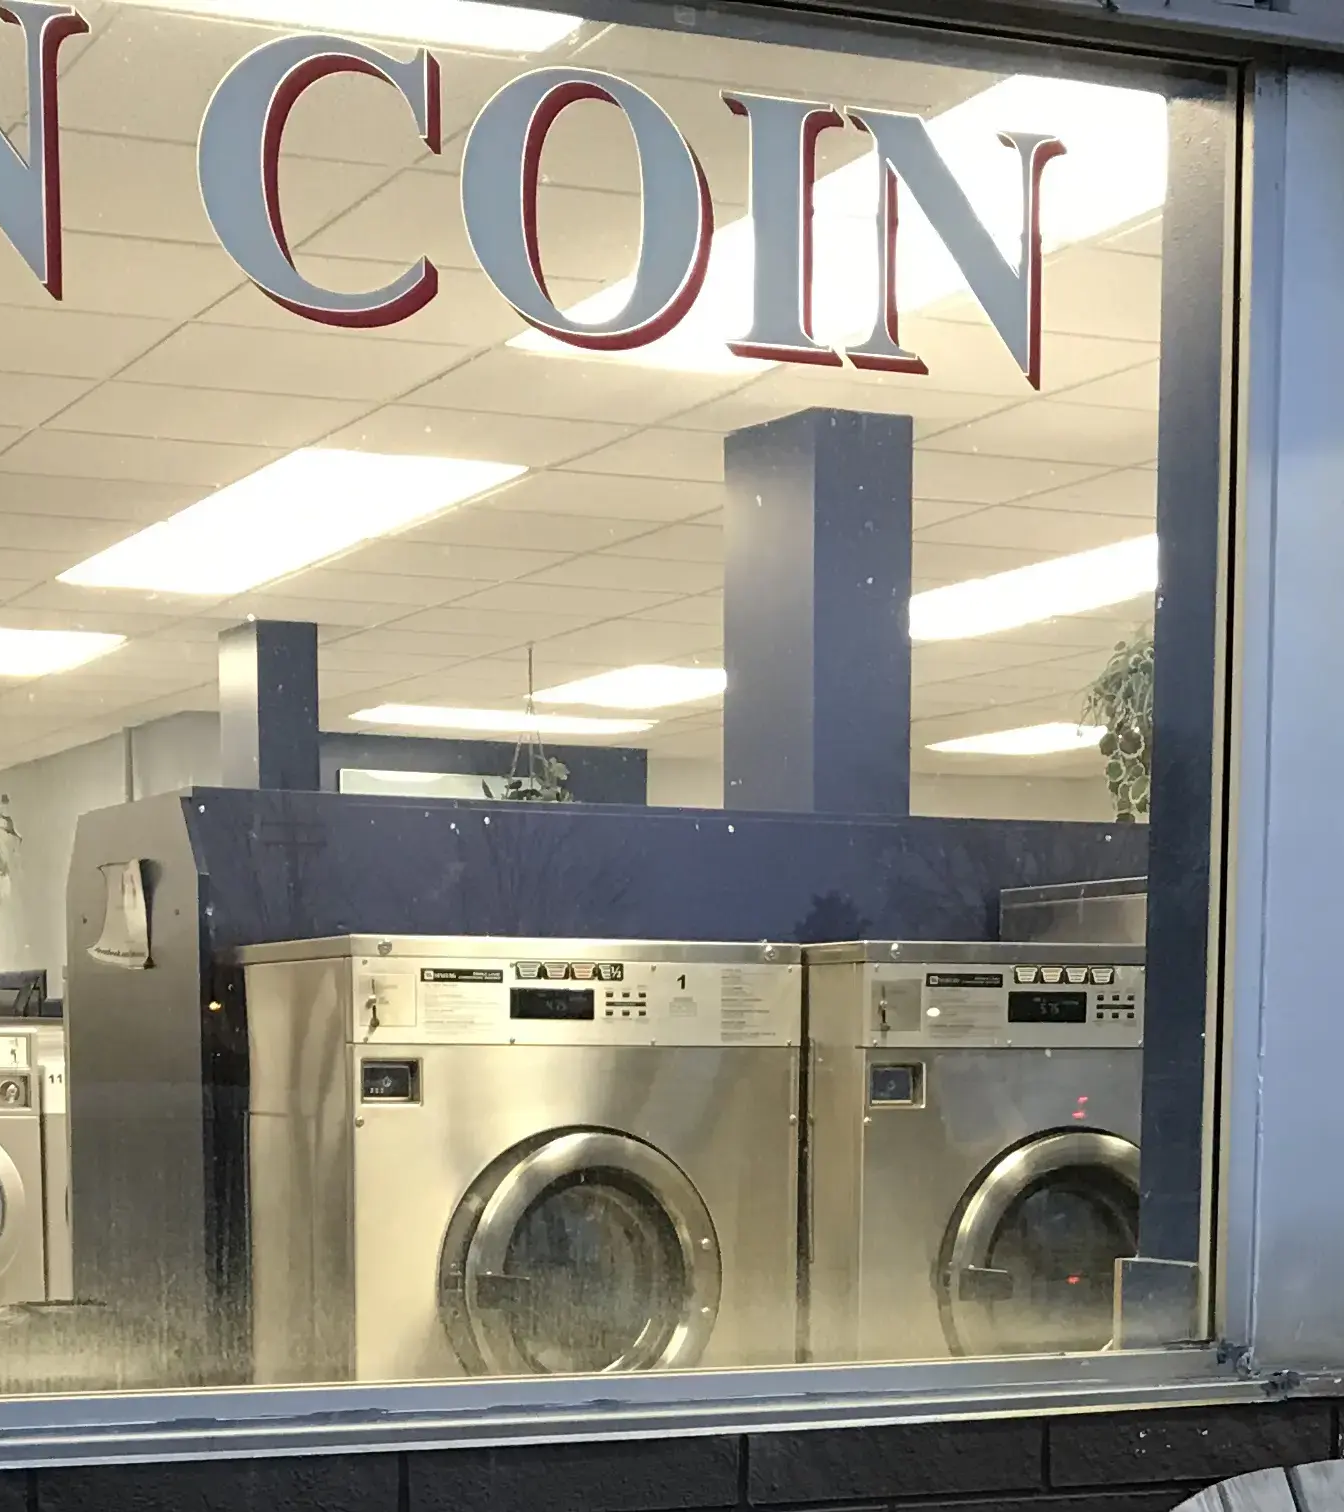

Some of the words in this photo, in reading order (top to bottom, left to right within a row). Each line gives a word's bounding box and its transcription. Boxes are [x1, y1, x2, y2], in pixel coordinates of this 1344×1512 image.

[197, 35, 1069, 390] COIN
[676, 974, 686, 990] 1
[48, 1073, 63, 1084] 11
